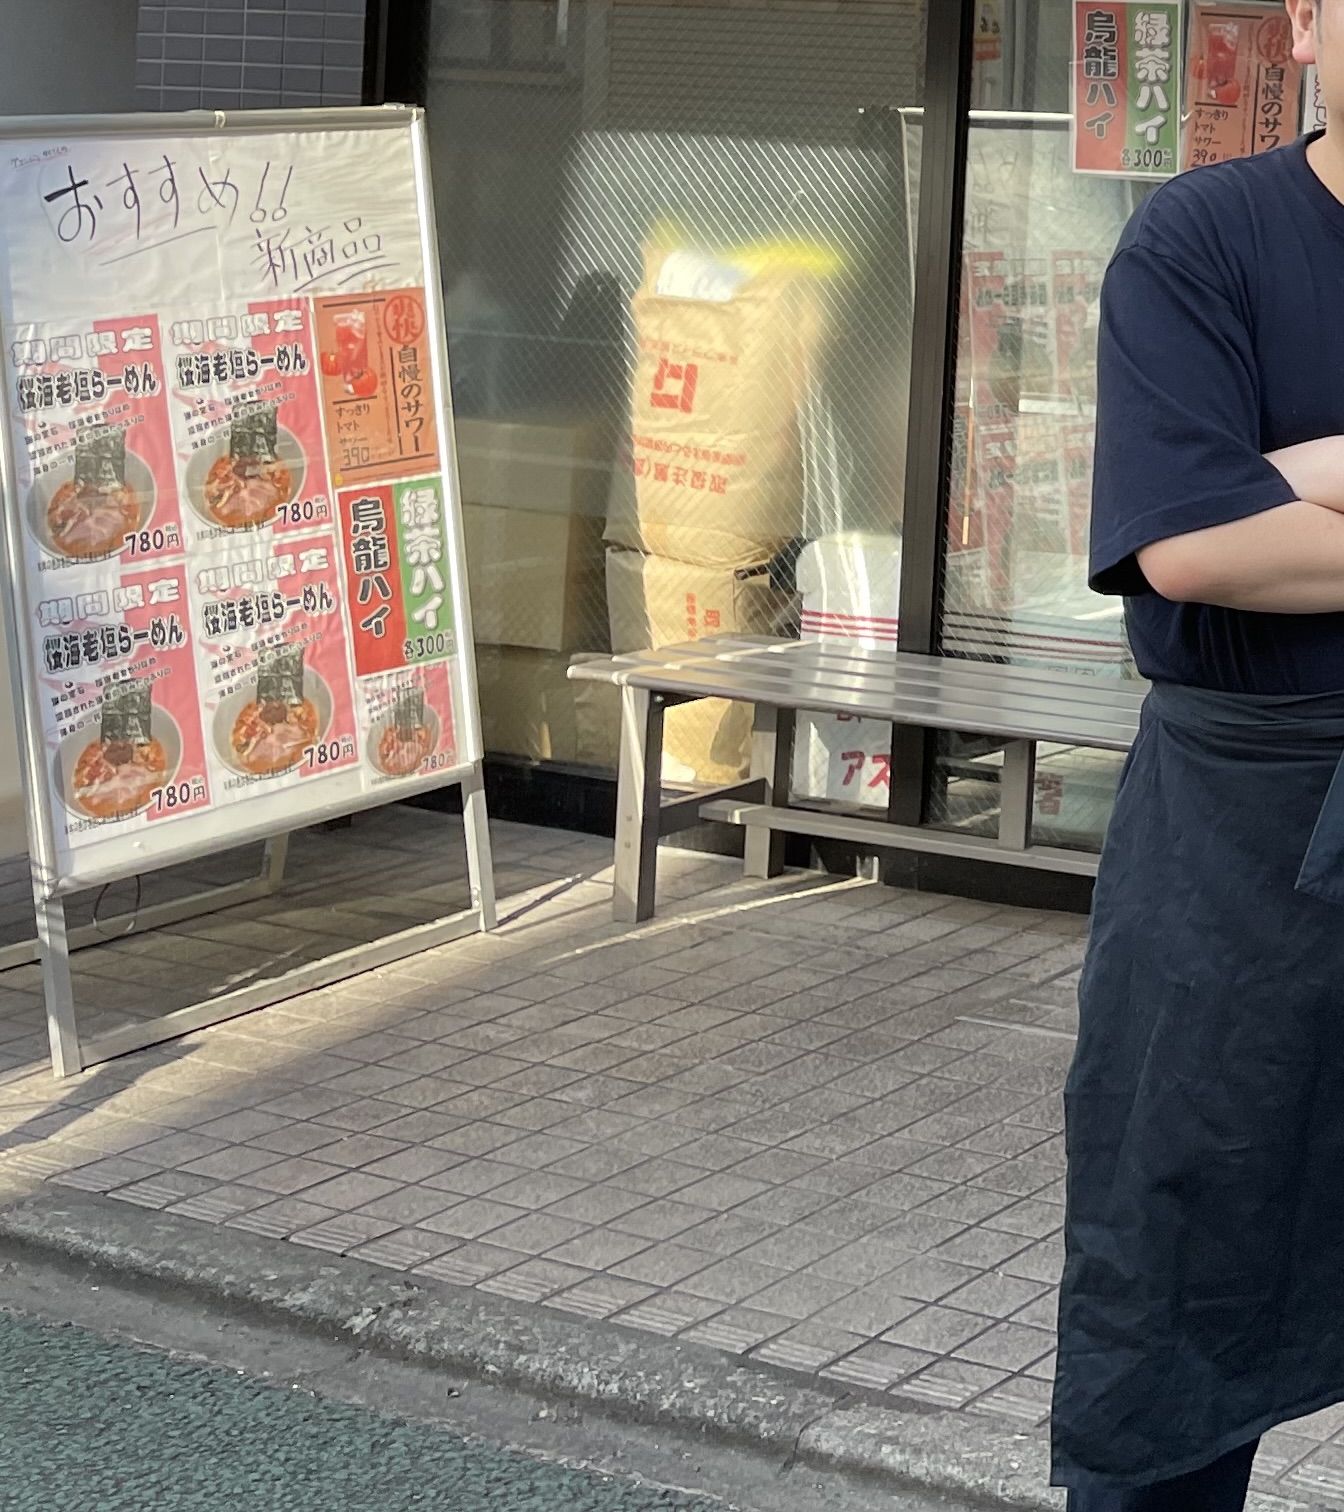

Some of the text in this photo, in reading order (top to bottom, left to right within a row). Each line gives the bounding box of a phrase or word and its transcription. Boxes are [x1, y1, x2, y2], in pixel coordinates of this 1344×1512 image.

[1084, 11, 1118, 139] 烏龍ハイ
[1134, 11, 1171, 146] 緑茶ハイ
[1194, 124, 1216, 133] トマト
[1195, 108, 1229, 120] すっきり
[250, 217, 384, 286] 新商品
[171, 309, 304, 345] 期間限定
[11, 327, 154, 366] 期間限定
[334, 402, 371, 418] すっきり
[397, 345, 424, 453] 自慢のサワー
[336, 419, 360, 434] トマト
[342, 445, 371, 467] 390
[278, 500, 328, 526] 780円
[125, 529, 180, 555] 780円
[400, 488, 444, 630] 緑茶ハイ
[197, 548, 330, 593] 期間限定
[351, 497, 392, 637] 烏龍ハイ
[38, 578, 180, 627] 期間限定
[303, 740, 355, 768] 780円
[151, 782, 206, 812] 780円
